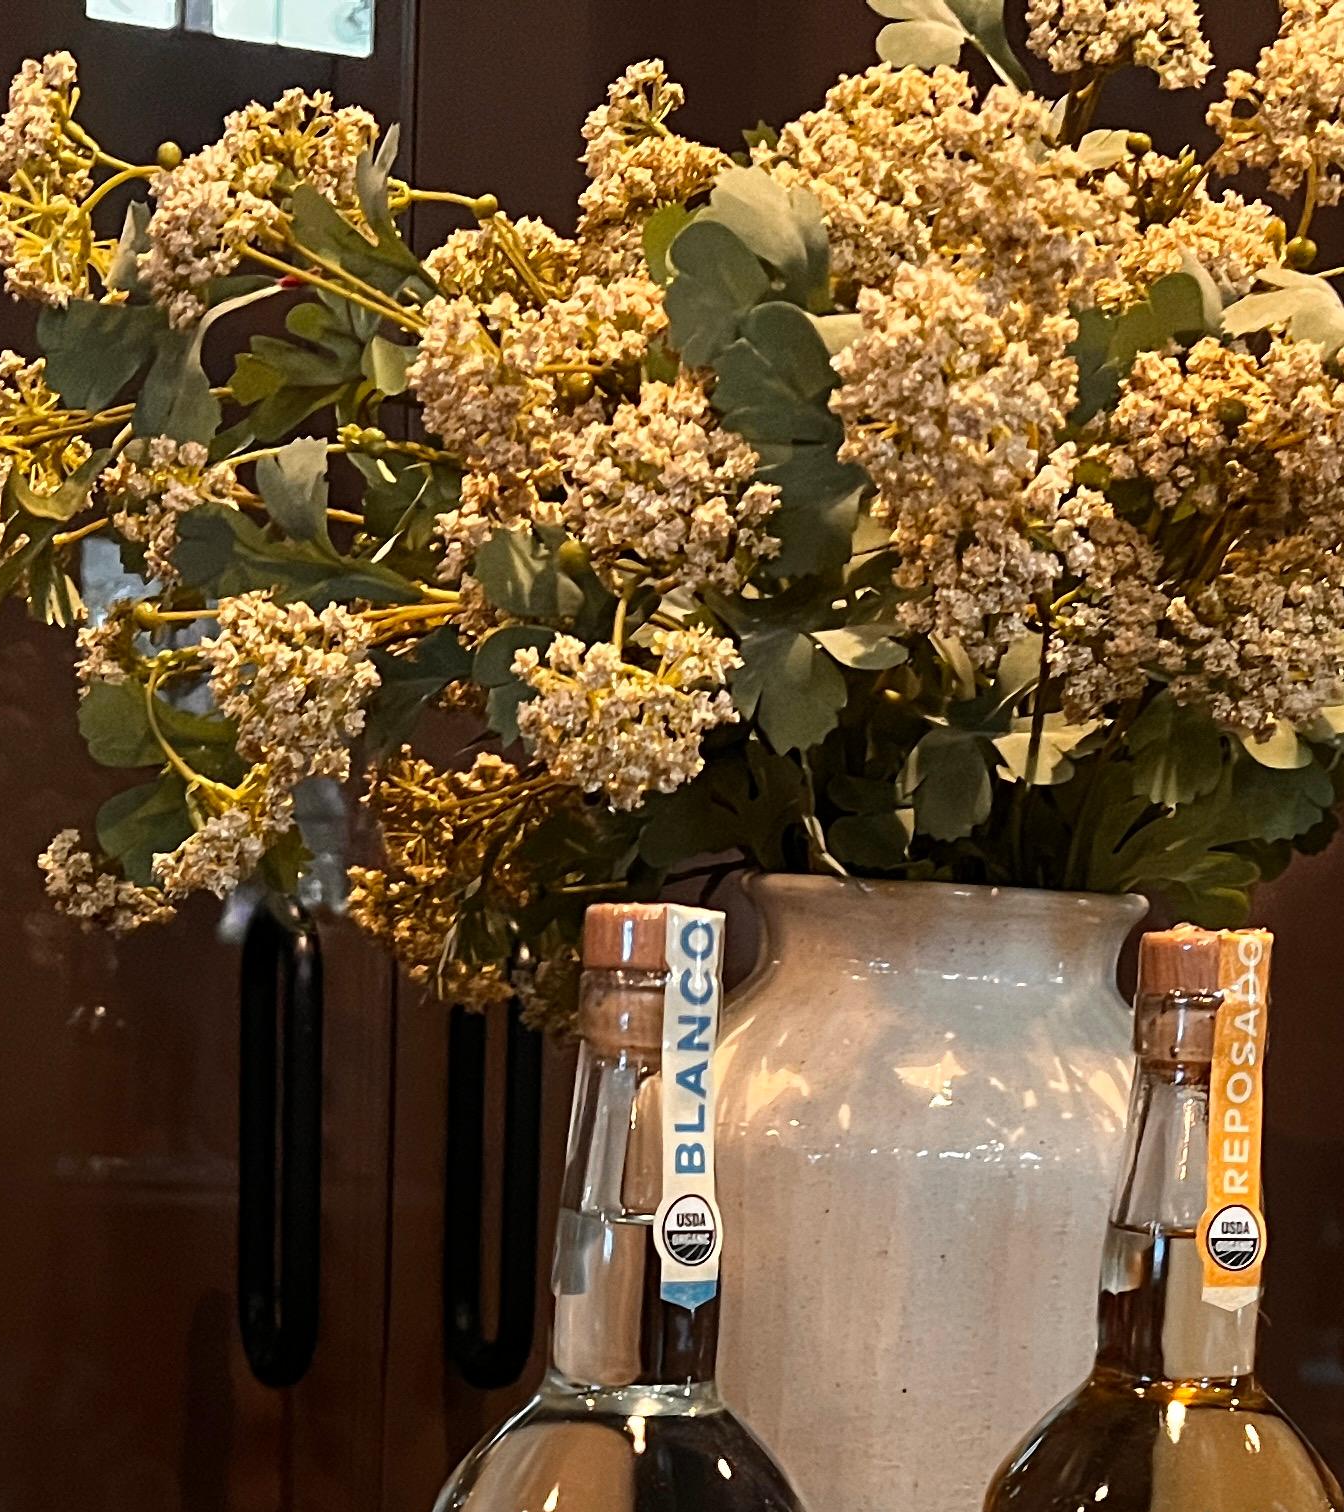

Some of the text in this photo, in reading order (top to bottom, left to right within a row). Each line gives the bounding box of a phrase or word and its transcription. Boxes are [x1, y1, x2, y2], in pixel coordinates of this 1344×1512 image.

[675, 919, 714, 1175] BLANCO
[1223, 936, 1263, 1195] REPOSADO
[676, 1213, 706, 1227] USDA
